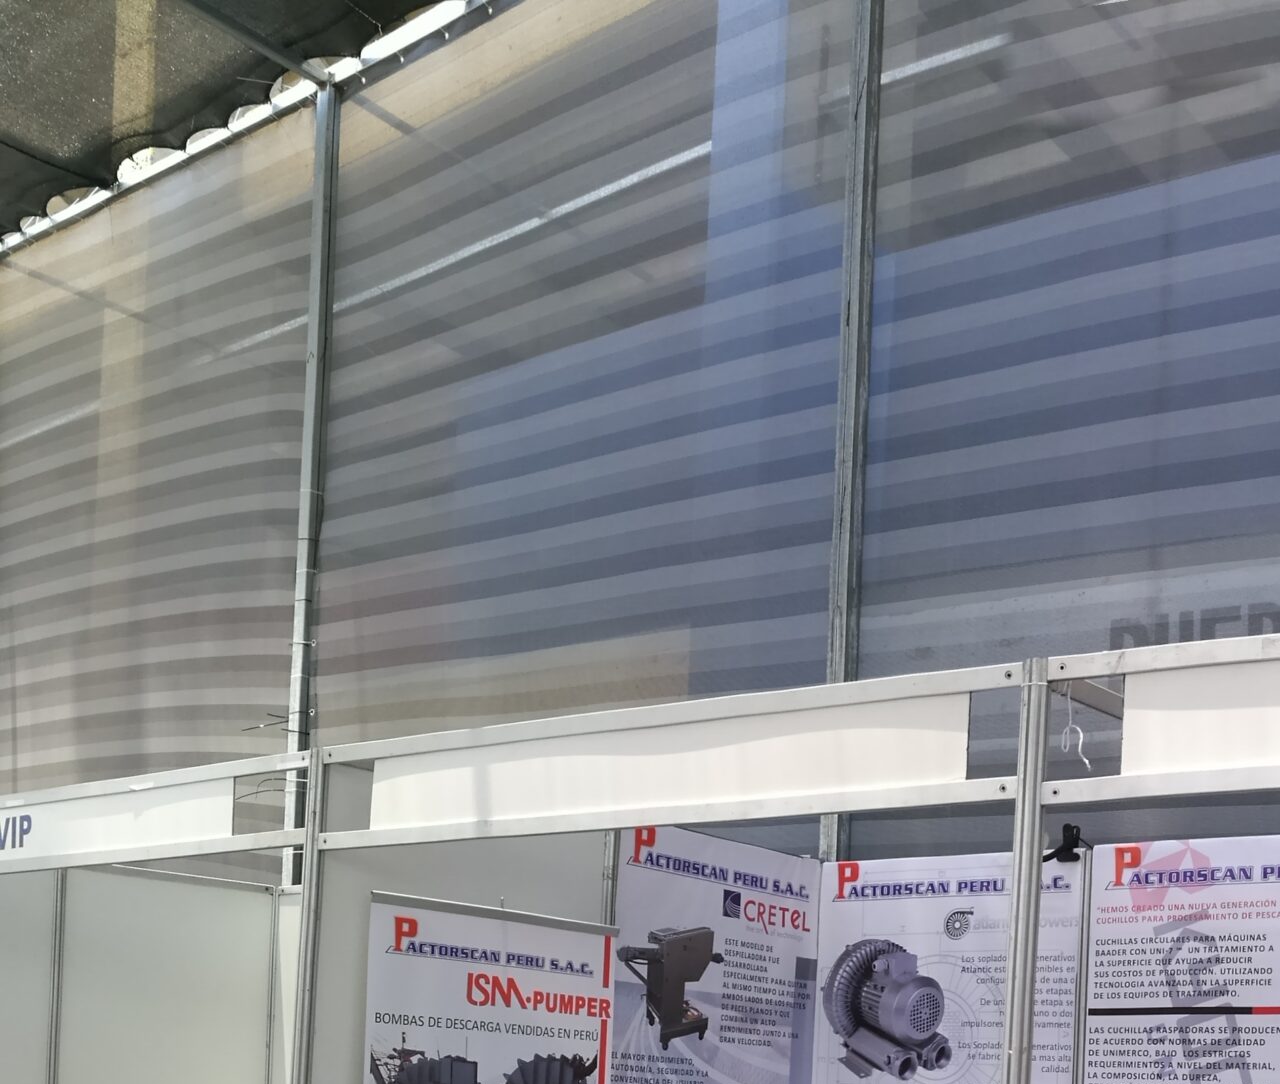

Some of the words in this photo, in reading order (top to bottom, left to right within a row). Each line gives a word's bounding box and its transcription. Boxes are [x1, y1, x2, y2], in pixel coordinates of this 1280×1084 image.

[632, 825, 728, 882] PACTORSCAN
[733, 871, 768, 890] PERU
[772, 880, 809, 899] S.A.C.
[1113, 846, 1253, 887] PACTORSCAN
[836, 860, 950, 900] PACTORSCAN
[957, 878, 1006, 893] PERU
[393, 915, 501, 963] PACTORSCAN
[506, 951, 545, 969] PERU
[550, 958, 594, 975] S.A.C.
[1095, 937, 1139, 946] CUCHILLAS
[1140, 936, 1191, 945] CIRCULARES
[1193, 935, 1216, 944] PARA
[1218, 933, 1267, 943] MÁQUINAS
[1093, 991, 1104, 1000] DE
[1106, 991, 1121, 1000] LOS
[1123, 991, 1161, 1000] EQUIPOS
[1162, 990, 1173, 999] DE
[1175, 990, 1240, 999] TRATAMIENTO.
[375, 1012, 425, 1028] BOMBAS
[428, 1017, 442, 1029] DE
[445, 1018, 501, 1034] DESCARGA
[504, 1023, 555, 1038] VENDIDAS
[558, 1028, 571, 1040] EN
[573, 1029, 599, 1042] PERÚ
[1089, 1026, 1105, 1035] LAS
[1107, 1026, 1154, 1035] CUCHILLAS
[1156, 1026, 1216, 1035] RASPADORAS
[1218, 1026, 1229, 1035] SE
